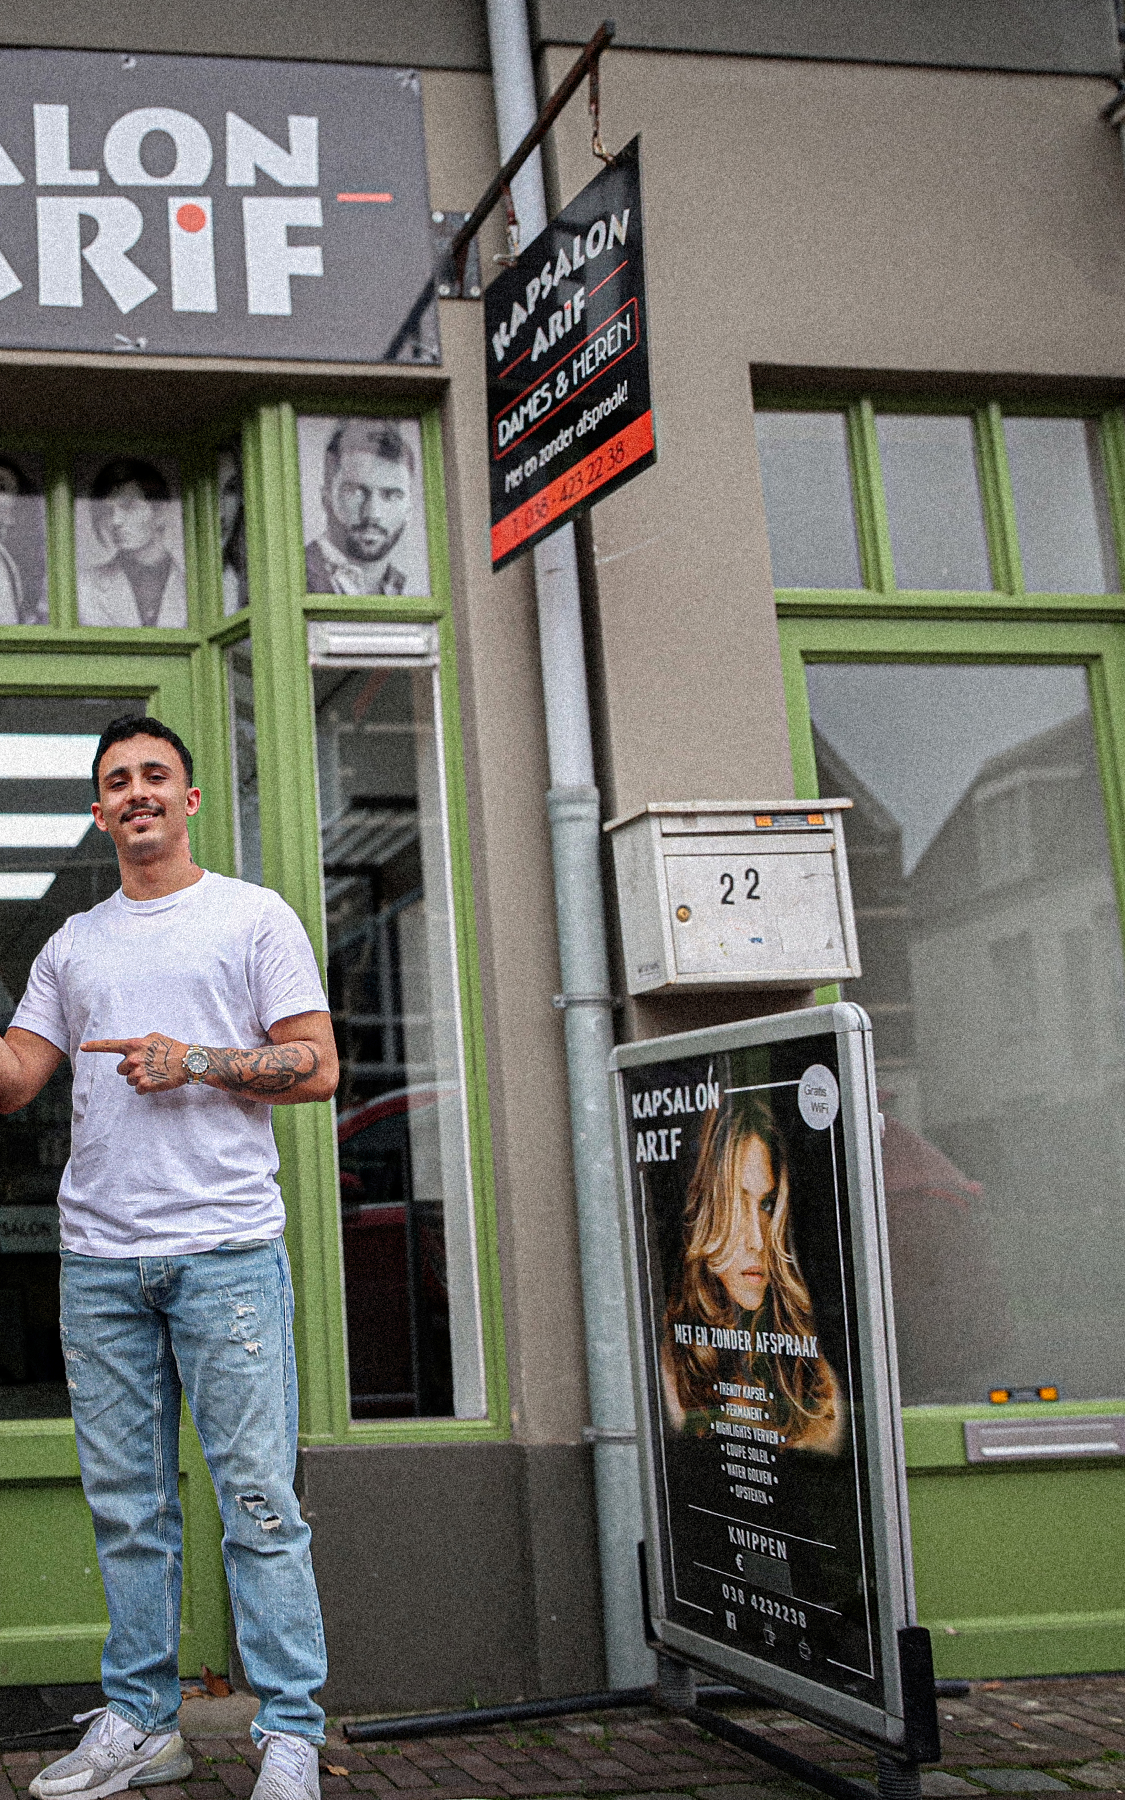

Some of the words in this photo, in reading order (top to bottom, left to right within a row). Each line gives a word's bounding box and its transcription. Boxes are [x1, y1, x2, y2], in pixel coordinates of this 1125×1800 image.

[491, 208, 630, 362] KAPSALON
[498, 382, 552, 447] DAMES
[555, 370, 569, 399] &
[573, 313, 631, 385] HEREN
[525, 455, 538, 477] en
[539, 425, 574, 466] zonder
[576, 379, 628, 437] afspraak!
[587, 456, 604, 484] 22
[608, 440, 625, 471] 38
[632, 1081, 720, 1119] KAPSALON
[804, 1084, 827, 1098] Gratis
[636, 1128, 682, 1164] ARIF
[674, 1324, 692, 1345] MET
[695, 1326, 708, 1347] EN
[710, 1327, 752, 1351] ZONDER
[756, 1332, 819, 1359] AFSPRAAK
[728, 1525, 787, 1560] KNIPPEN
[722, 1583, 745, 1605] 038
[751, 1594, 807, 1629] 4232238
